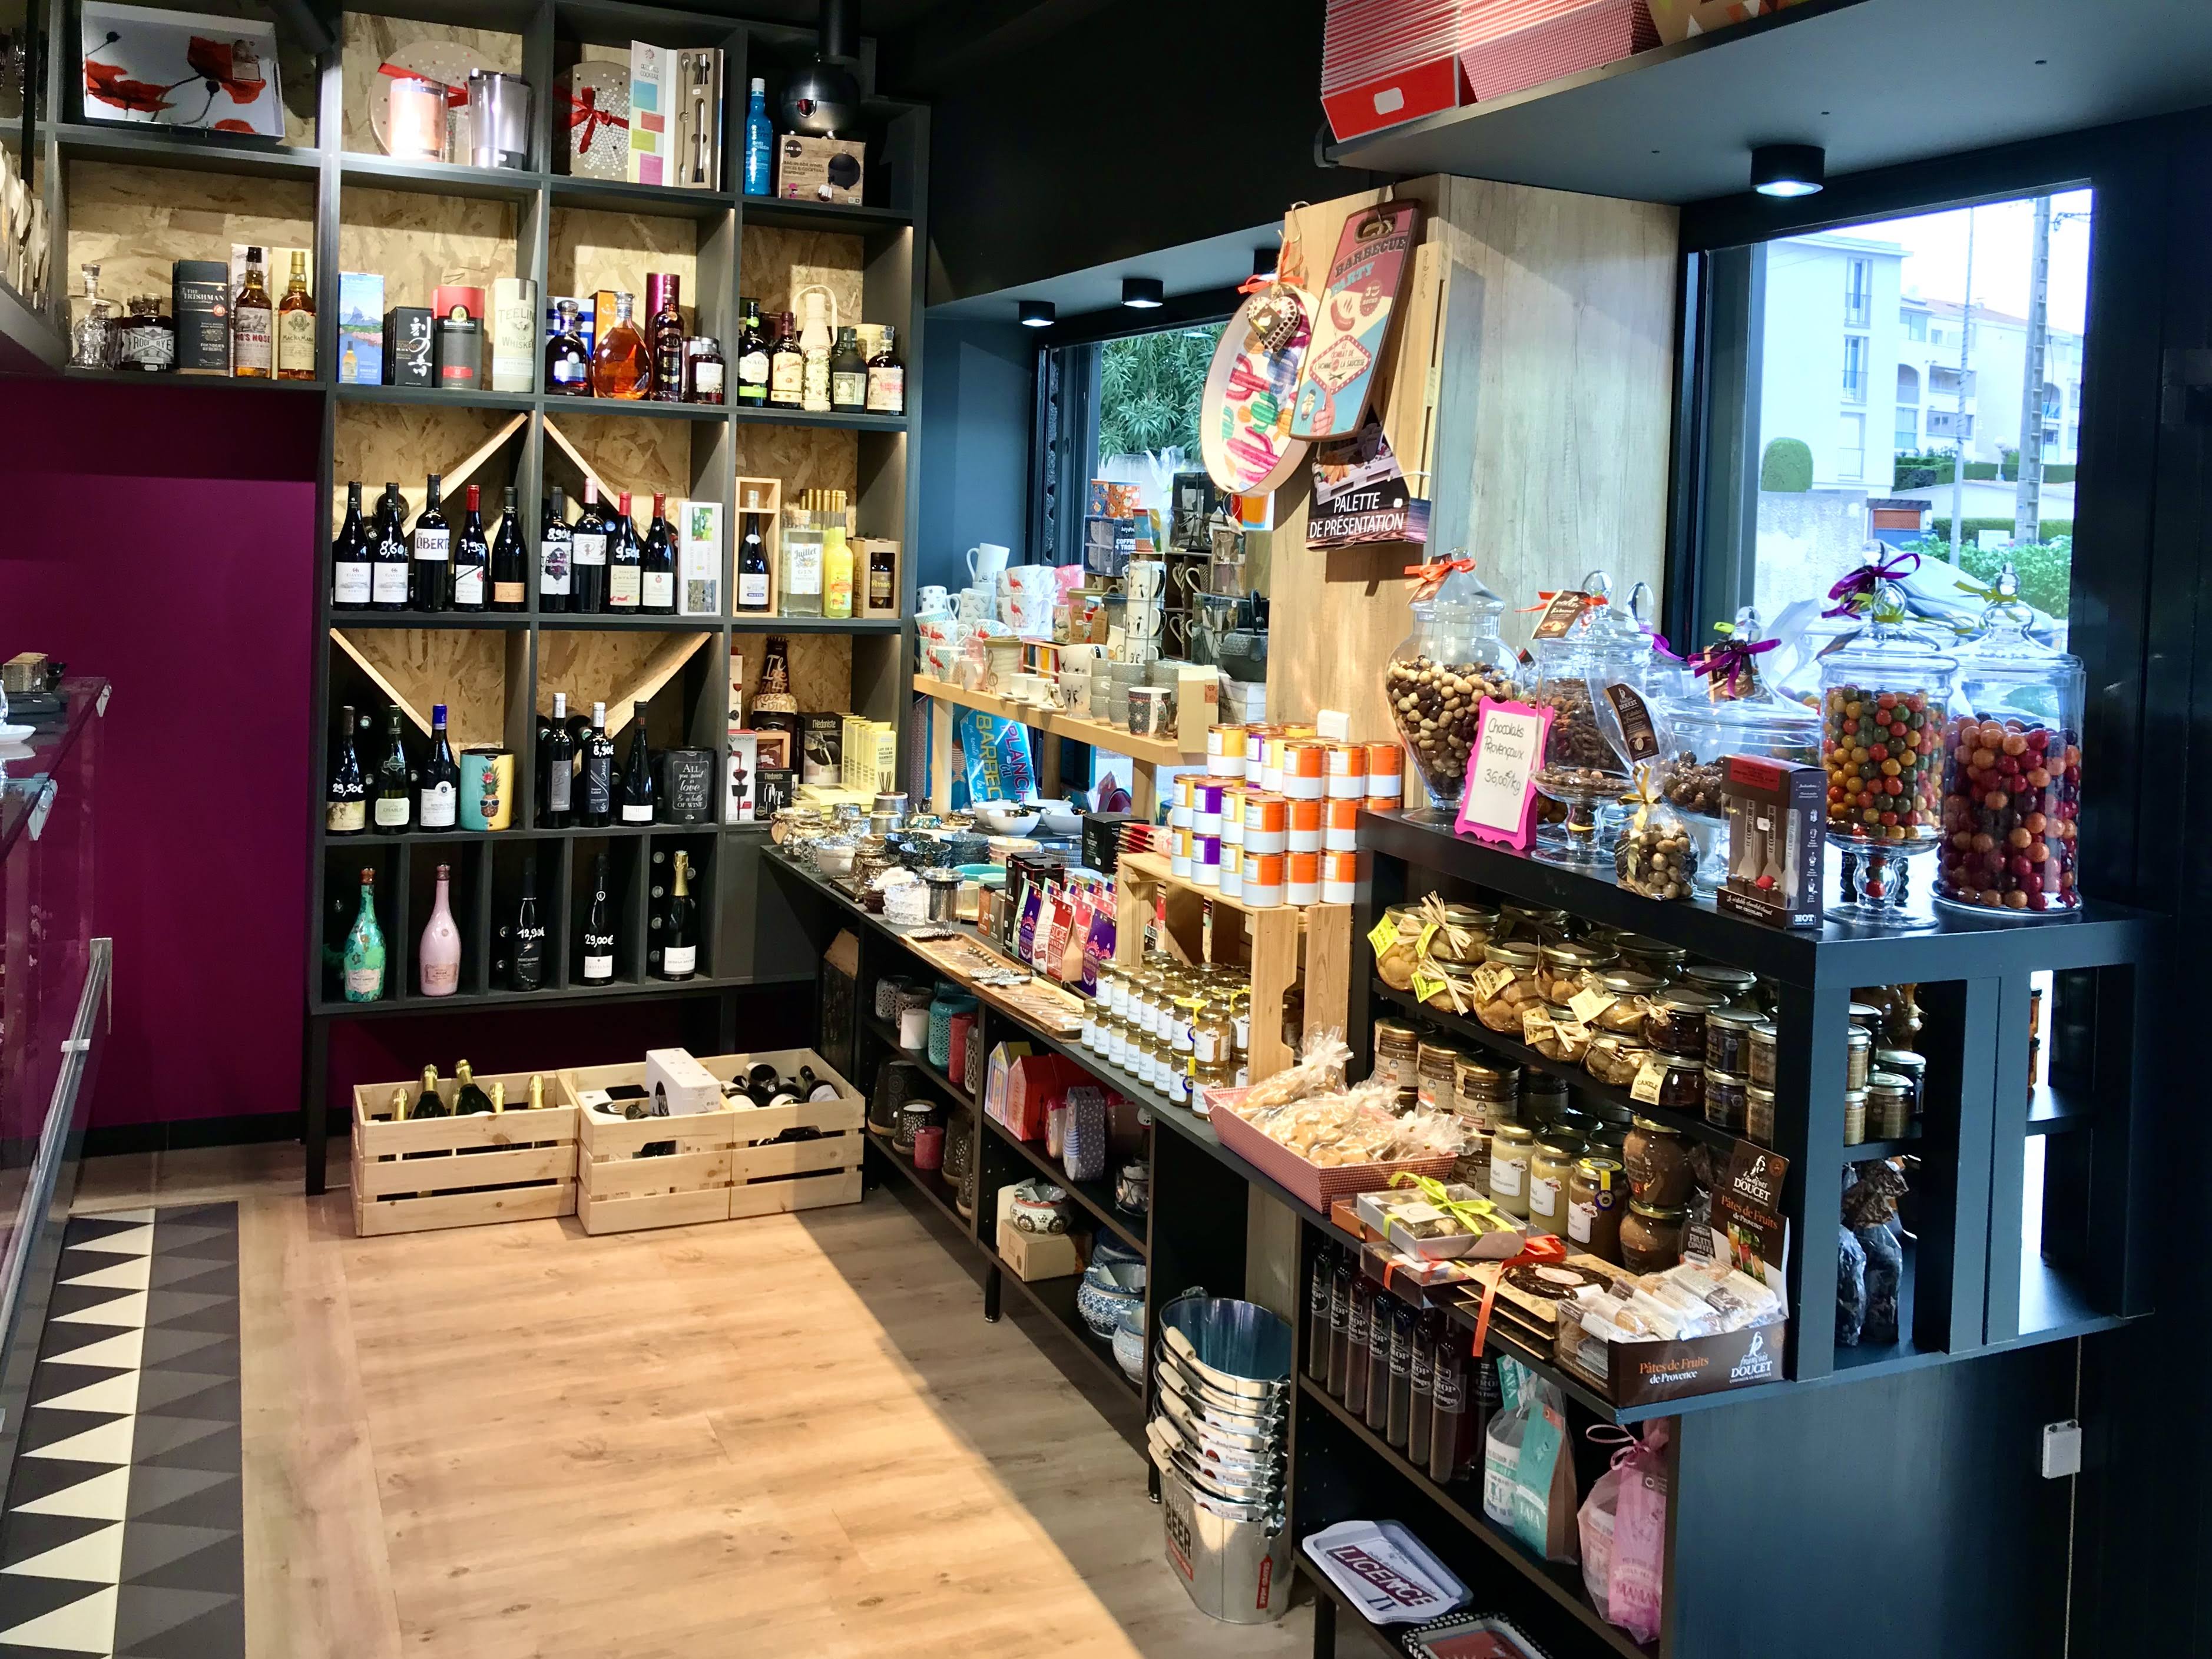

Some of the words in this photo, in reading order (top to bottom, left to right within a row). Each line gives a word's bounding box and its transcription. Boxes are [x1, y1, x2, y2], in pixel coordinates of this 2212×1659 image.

[1335, 236, 1406, 278] BARBECUE
[1330, 261, 1375, 298] PARTY
[184, 293, 224, 302] IRISHMAN
[156, 338, 172, 351] RYE
[252, 334, 270, 342] NOSE
[1333, 492, 1381, 514] PALETTE
[1309, 521, 1323, 538] DE
[1324, 513, 1404, 537] PRÉSENTATION
[794, 548, 817, 560] Juillet
[1488, 718, 1524, 738] Chocolats
[976, 715, 1004, 799] BARBEC
[1001, 725, 1030, 803] PLANCH
[683, 763, 699, 773] ALL
[333, 783, 364, 797] 29,50€
[680, 781, 700, 792] love
[1794, 914, 1814, 922] HOT
[584, 934, 614, 948] 29,00€
[1734, 1177, 1771, 1201] DOUCET
[1721, 1194, 1743, 1213] Pâtes
[1743, 1205, 1753, 1218] de
[1754, 1210, 1779, 1230] Fruits
[1739, 1214, 1764, 1231] Provence
[1639, 1360, 1667, 1375] Pâtes
[1667, 1359, 1680, 1370] de
[1681, 1356, 1709, 1370] Fruits
[1730, 1360, 1773, 1379] DOUCET
[1649, 1373, 1660, 1385] de
[1661, 1370, 1698, 1383] Provence
[1226, 1455, 1238, 1463] Party
[1223, 1475, 1236, 1484] Party
[1165, 1499, 1191, 1560] BEER
